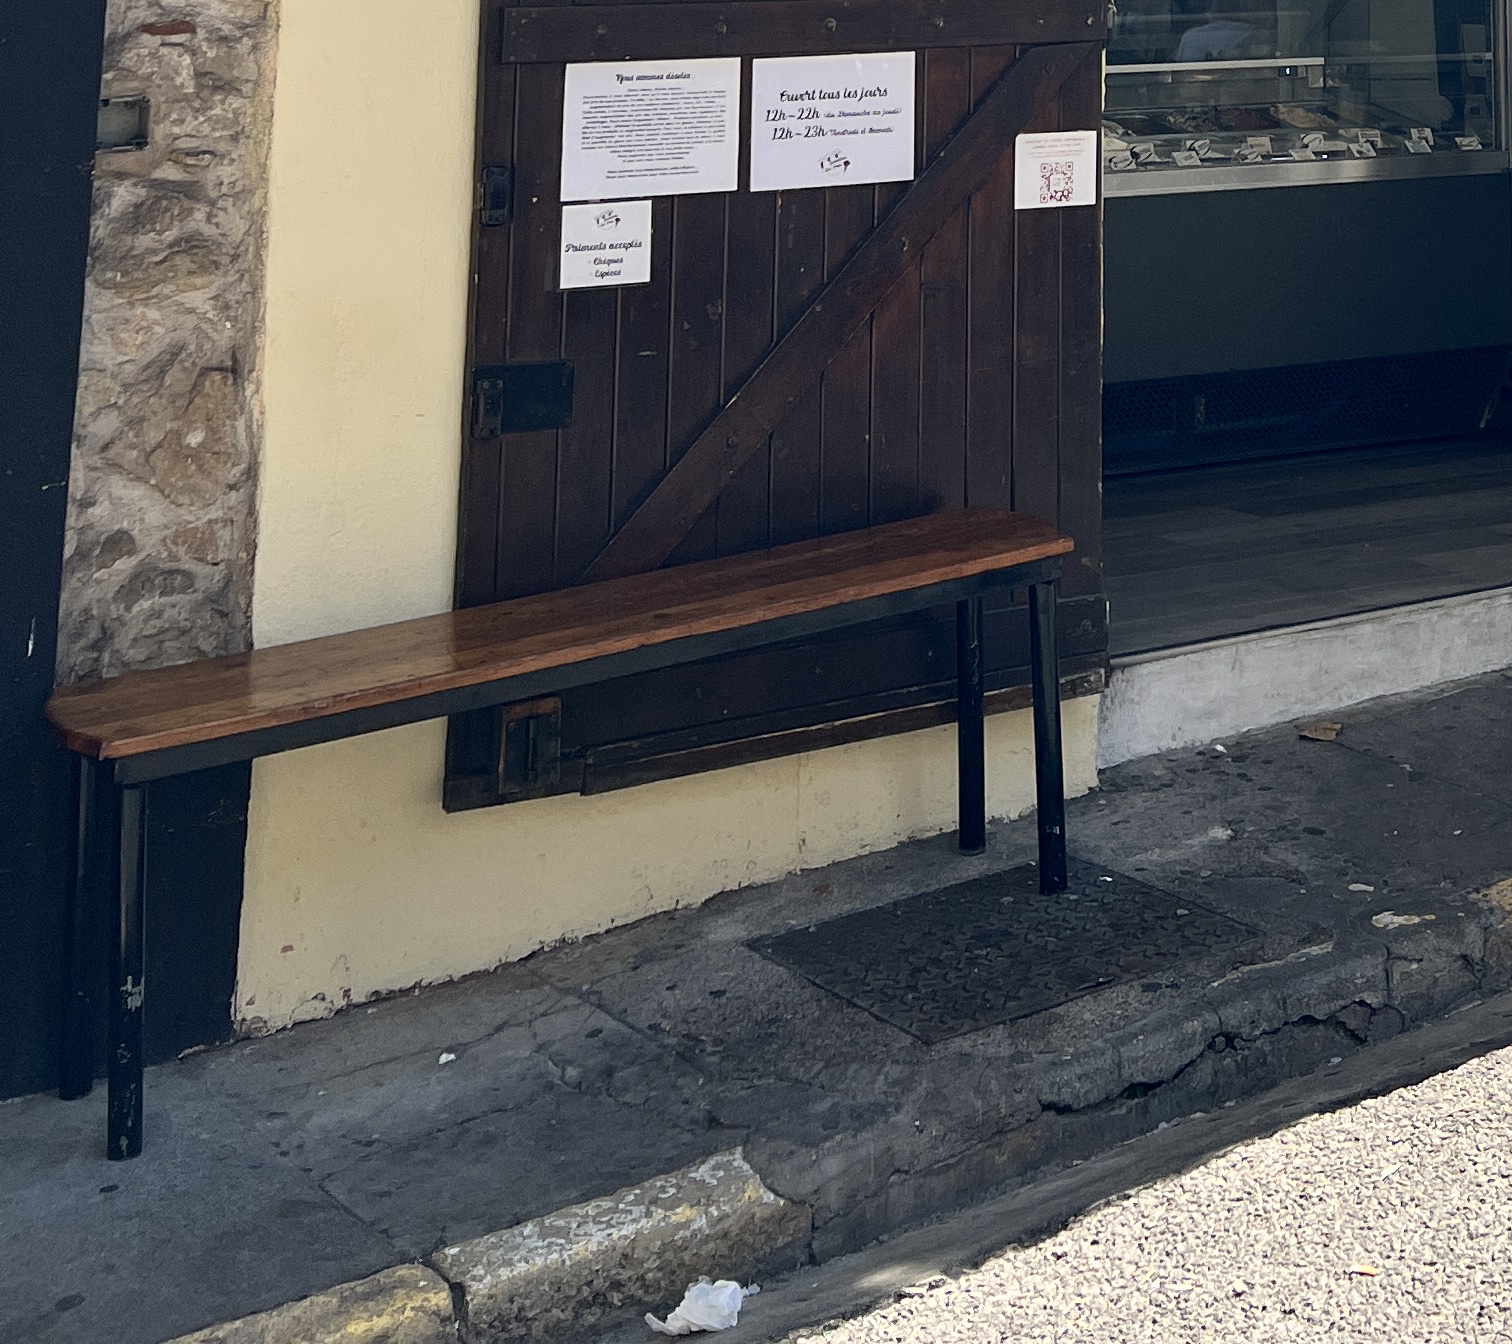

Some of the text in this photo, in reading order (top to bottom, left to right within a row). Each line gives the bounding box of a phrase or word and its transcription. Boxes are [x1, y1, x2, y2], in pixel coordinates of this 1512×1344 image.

[780, 86, 888, 102] Ouvert tous les jours
